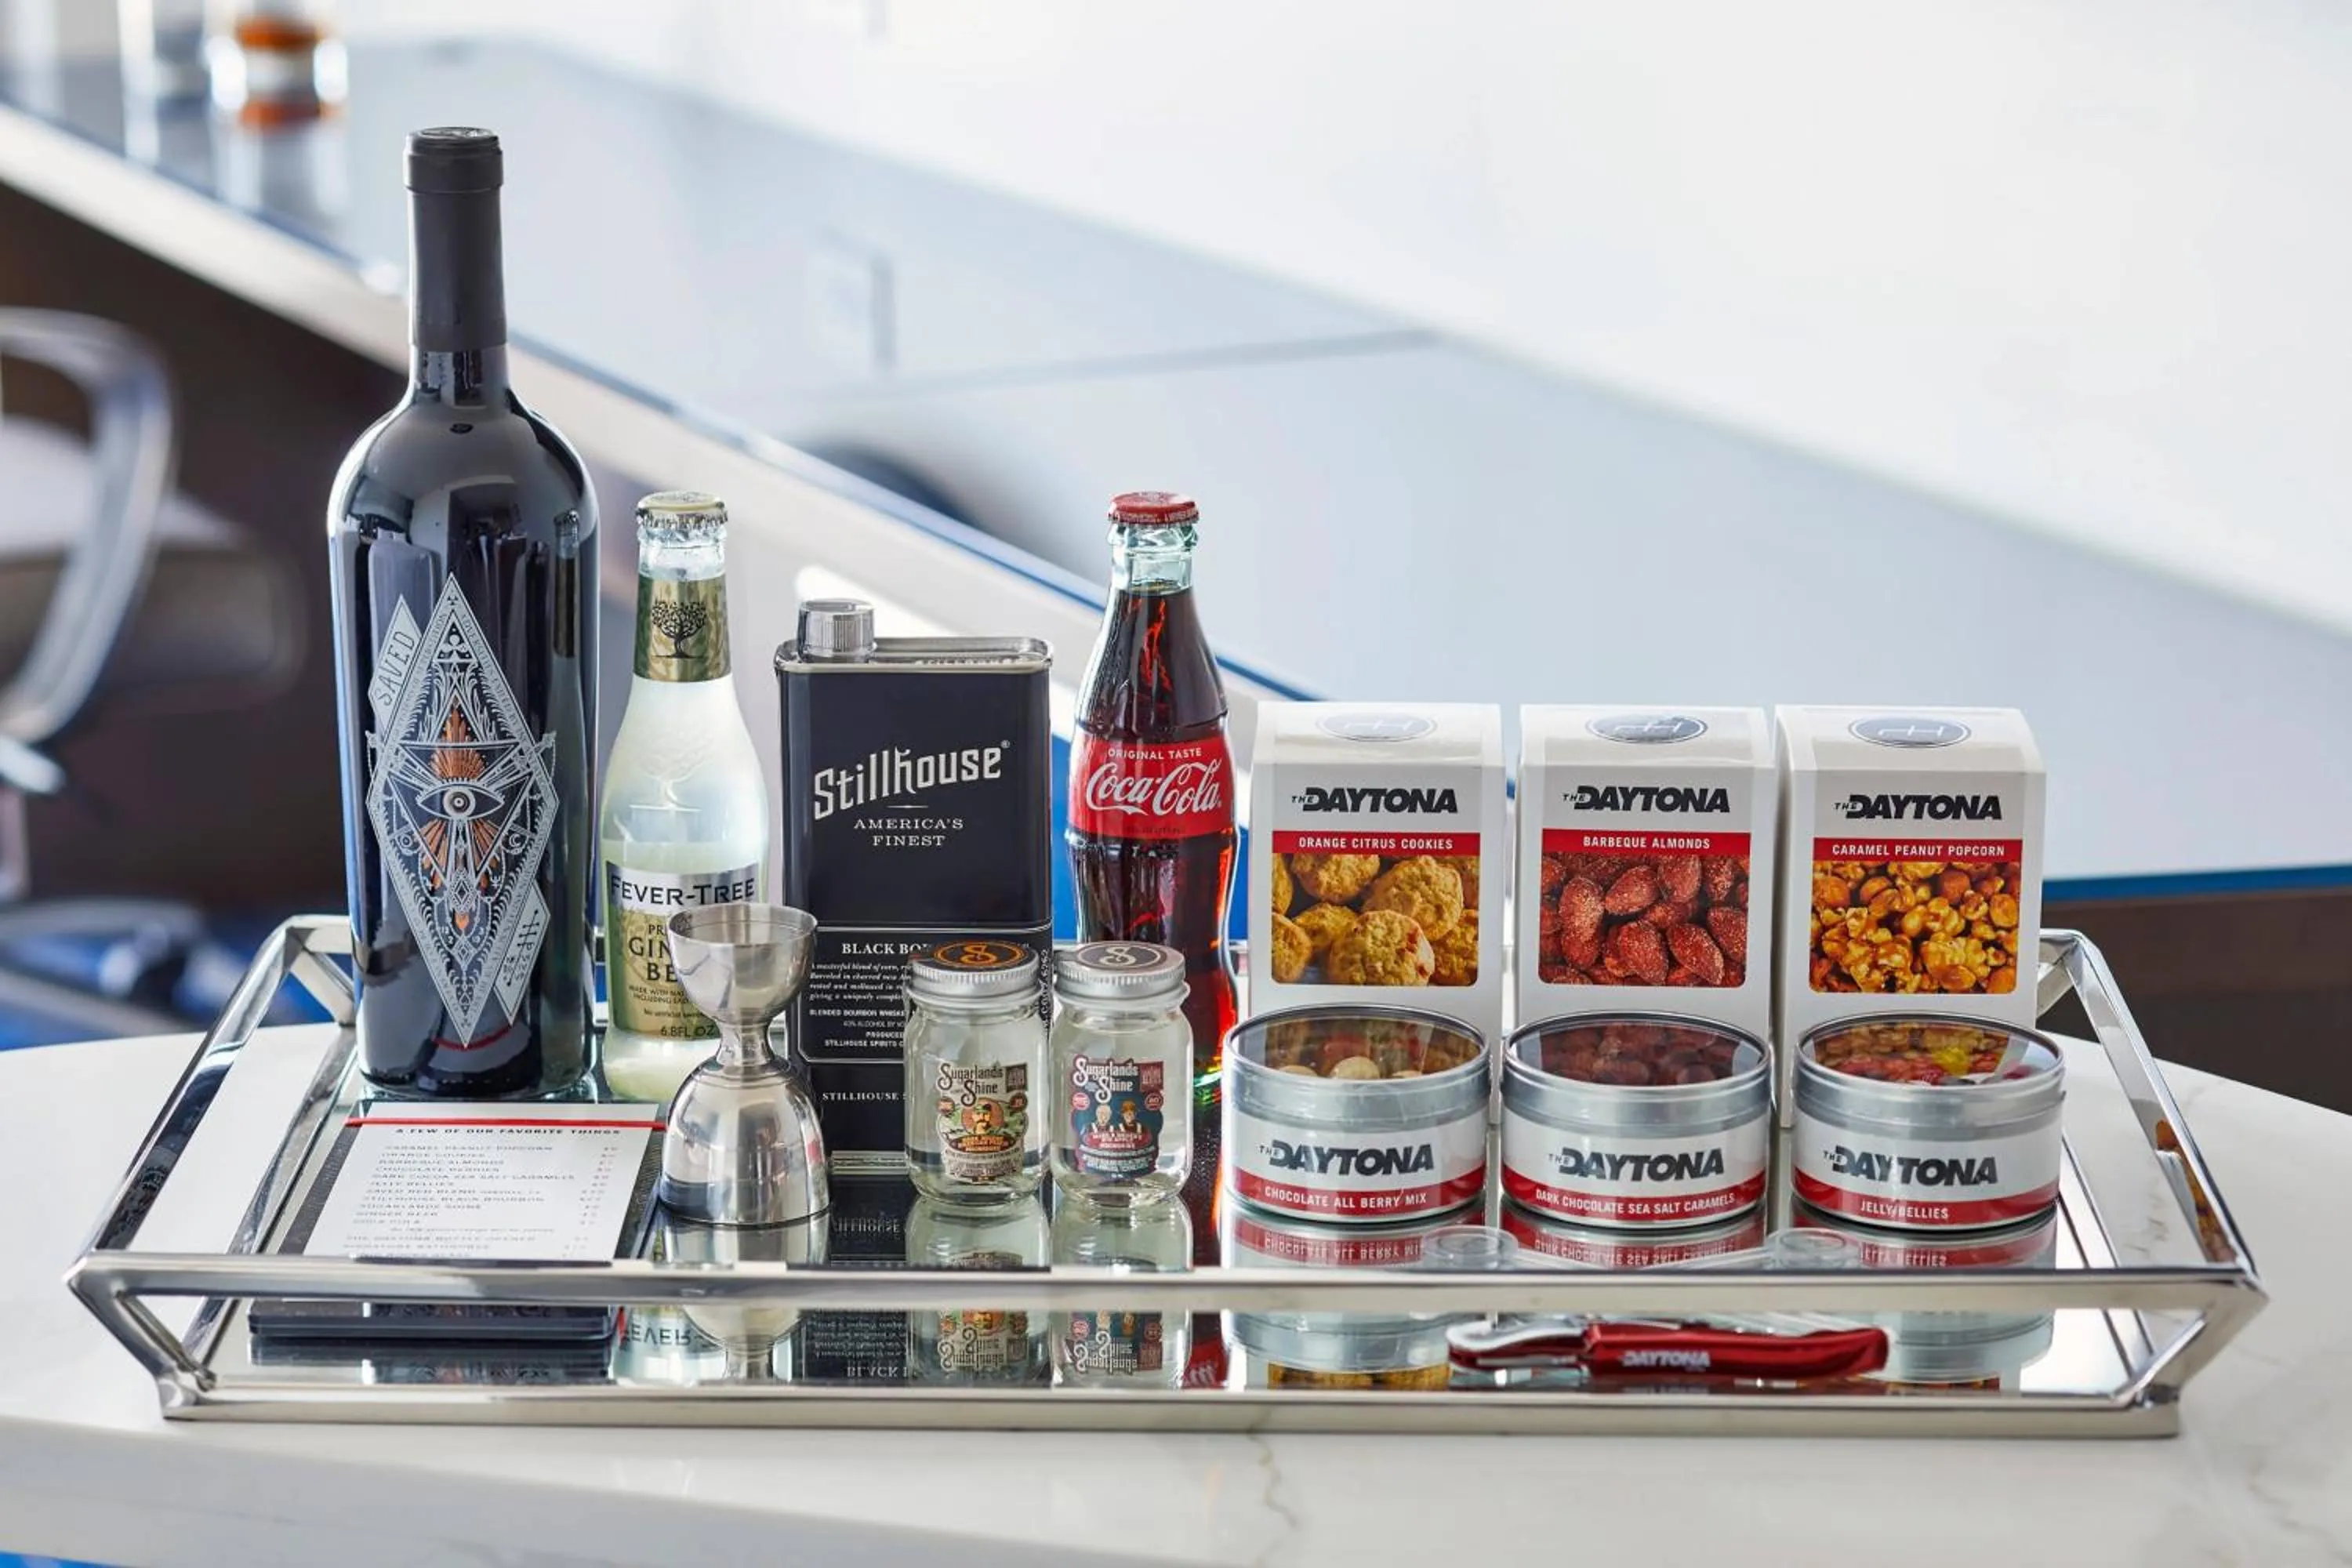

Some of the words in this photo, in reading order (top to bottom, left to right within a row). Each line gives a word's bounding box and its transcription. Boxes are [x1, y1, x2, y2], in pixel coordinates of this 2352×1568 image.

[375, 630, 416, 706] SAVED
[1107, 749, 1164, 760] ORIGINAL
[1168, 747, 1202, 759] TASTE
[814, 746, 1001, 820] Stillhouse
[1086, 758, 1222, 816] Coca-Cola
[1290, 795, 1314, 804] THE
[1302, 787, 1458, 813] DAYTONA
[1563, 793, 1585, 802] THE
[1573, 786, 1730, 813] DAYTONA
[1833, 802, 1858, 811] THE
[1846, 793, 2002, 820] DAYTONA
[853, 818, 964, 829] AMERICA'S
[873, 835, 946, 847] FINEST
[1298, 837, 1348, 849] ORANGE
[1352, 837, 1396, 849] CITRUS
[1400, 838, 1454, 850] COOKIES
[1582, 836, 1647, 848] BARBEQUE
[1651, 837, 1711, 849] ALMONDS
[1831, 844, 1890, 856] CARAMEL
[1894, 844, 1943, 856] PEANUT
[1947, 844, 2005, 857] POPCORN
[611, 875, 755, 906] FEVER-TREE
[628, 936, 672, 959] GIN
[841, 943, 895, 954] BLACK
[647, 962, 678, 982] BE
[937, 1062, 1004, 1091] Sugarlands
[1073, 1057, 1139, 1087] Sugarlands
[822, 1092, 900, 1101] STILLHOUSE
[960, 1080, 999, 1107] Shine
[1094, 1076, 1134, 1104] Shine
[1269, 1139, 1435, 1176] DAYTONA
[1559, 1147, 1724, 1182] DAYTONA
[1823, 1150, 1842, 1163] THE
[1832, 1145, 1998, 1186] DAYTONA
[1264, 1185, 1330, 1207] CHOCOLATE
[1334, 1197, 1356, 1209] ALL
[1359, 1196, 1400, 1208] BERRY
[1404, 1192, 1427, 1205] MIX
[1535, 1189, 1560, 1205] DARK
[1562, 1196, 1624, 1214] CHOCOLATE
[1628, 1203, 1650, 1214] SEA
[1653, 1202, 1680, 1214] SALT
[1683, 1192, 1736, 1212] CARAMELS
[1860, 1200, 1893, 1215] JELLY
[1897, 1207, 1950, 1220] BELLIES
[1622, 1349, 1711, 1367] DAYTONA
